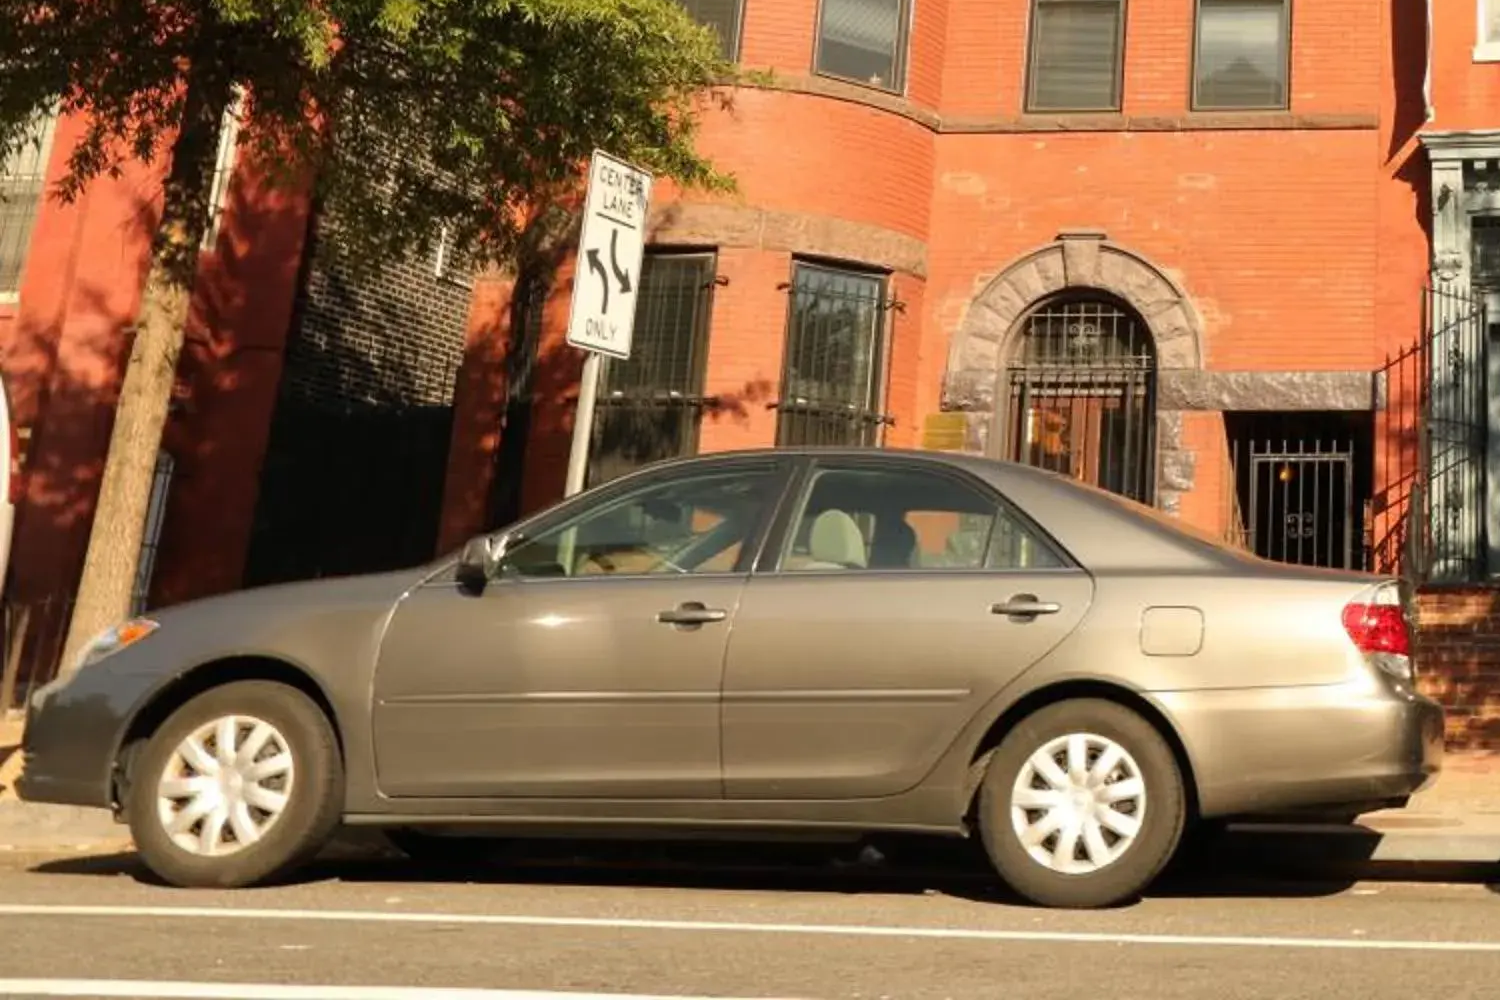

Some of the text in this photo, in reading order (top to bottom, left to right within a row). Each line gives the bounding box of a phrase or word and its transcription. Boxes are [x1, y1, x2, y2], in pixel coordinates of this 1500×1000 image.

[599, 165, 644, 196] CENTER
[603, 196, 633, 219] LANE
[585, 317, 618, 341] ONLY
